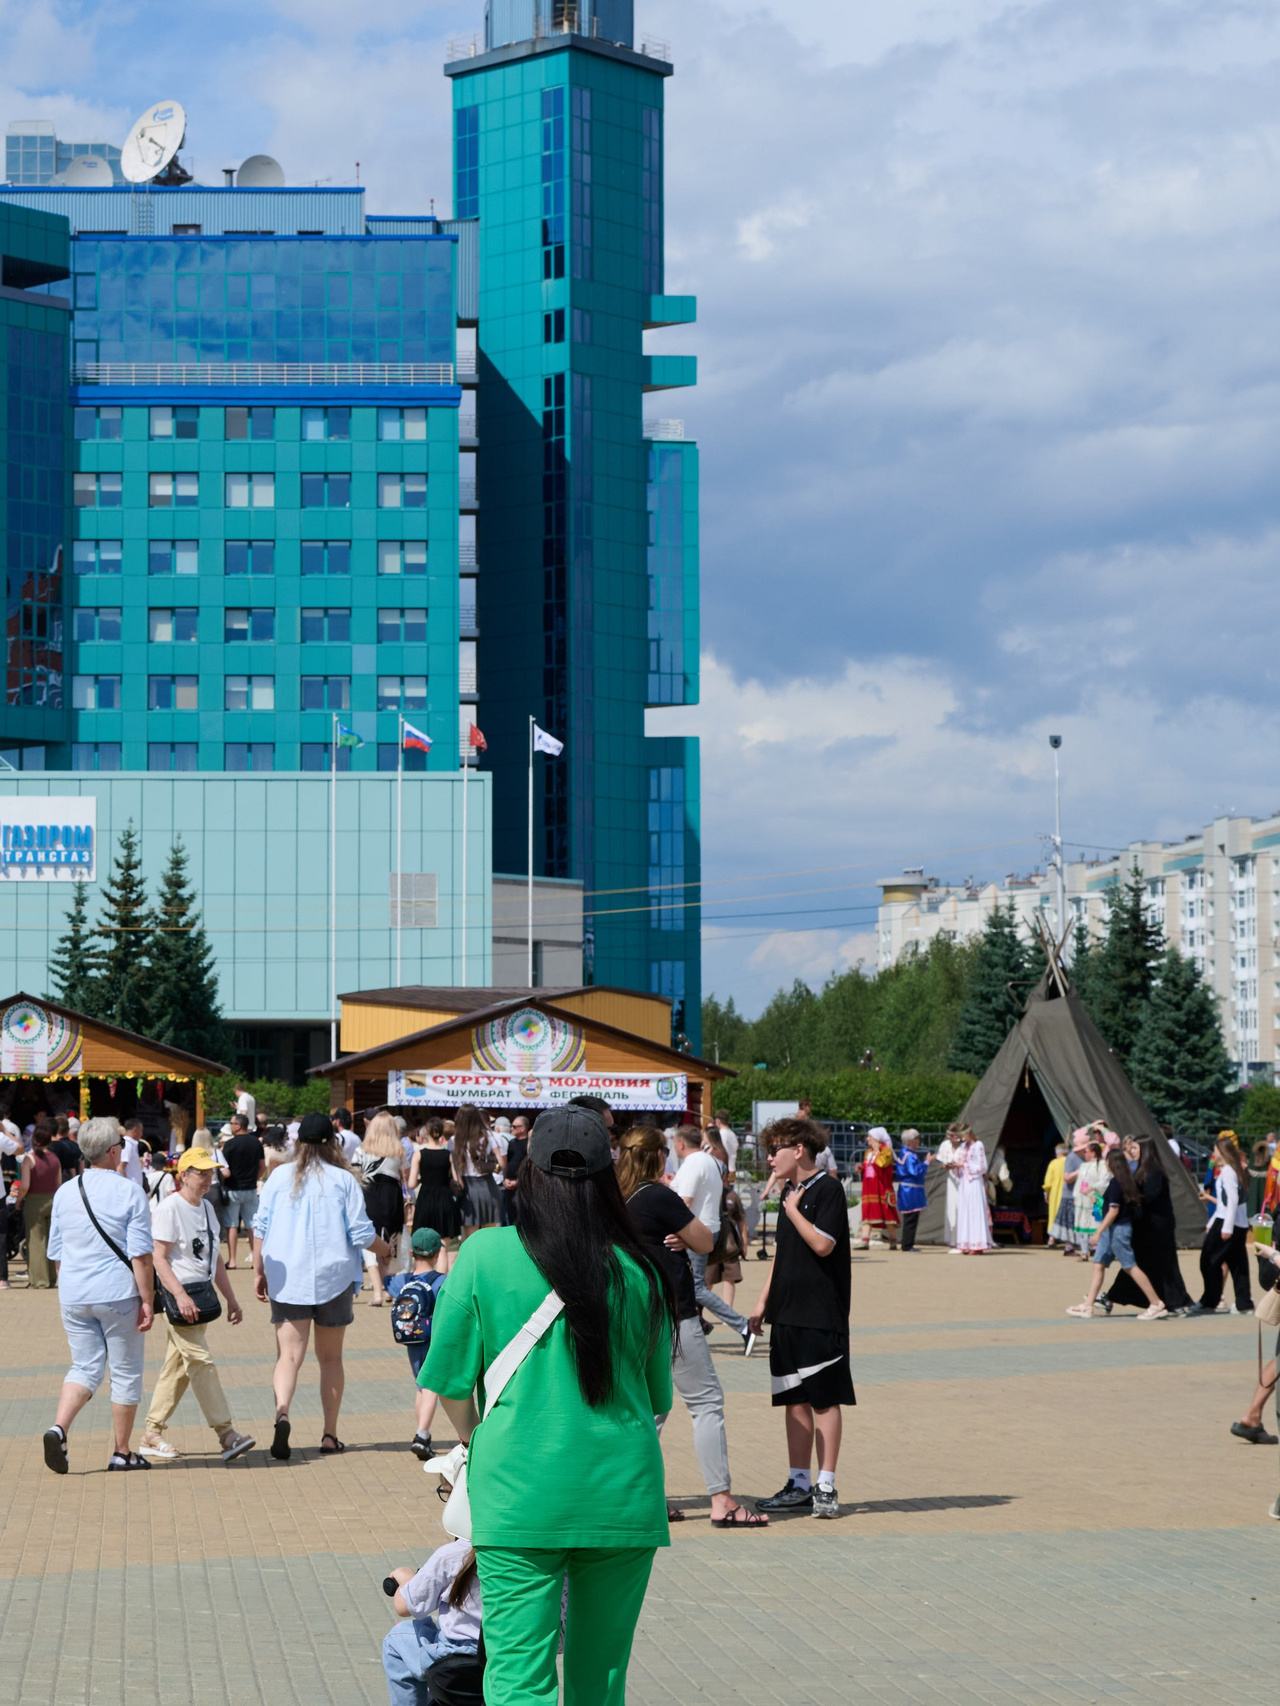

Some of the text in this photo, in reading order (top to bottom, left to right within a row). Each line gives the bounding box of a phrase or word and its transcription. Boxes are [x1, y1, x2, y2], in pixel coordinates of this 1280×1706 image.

[3, 825, 91, 848] ГАЗПРОМ
[5, 851, 90, 862] ТРАНСГАЗ
[432, 1075, 651, 1088] СУРГУТ МОРДОВИЯ
[447, 1090, 512, 1098] ШУМБРАТ
